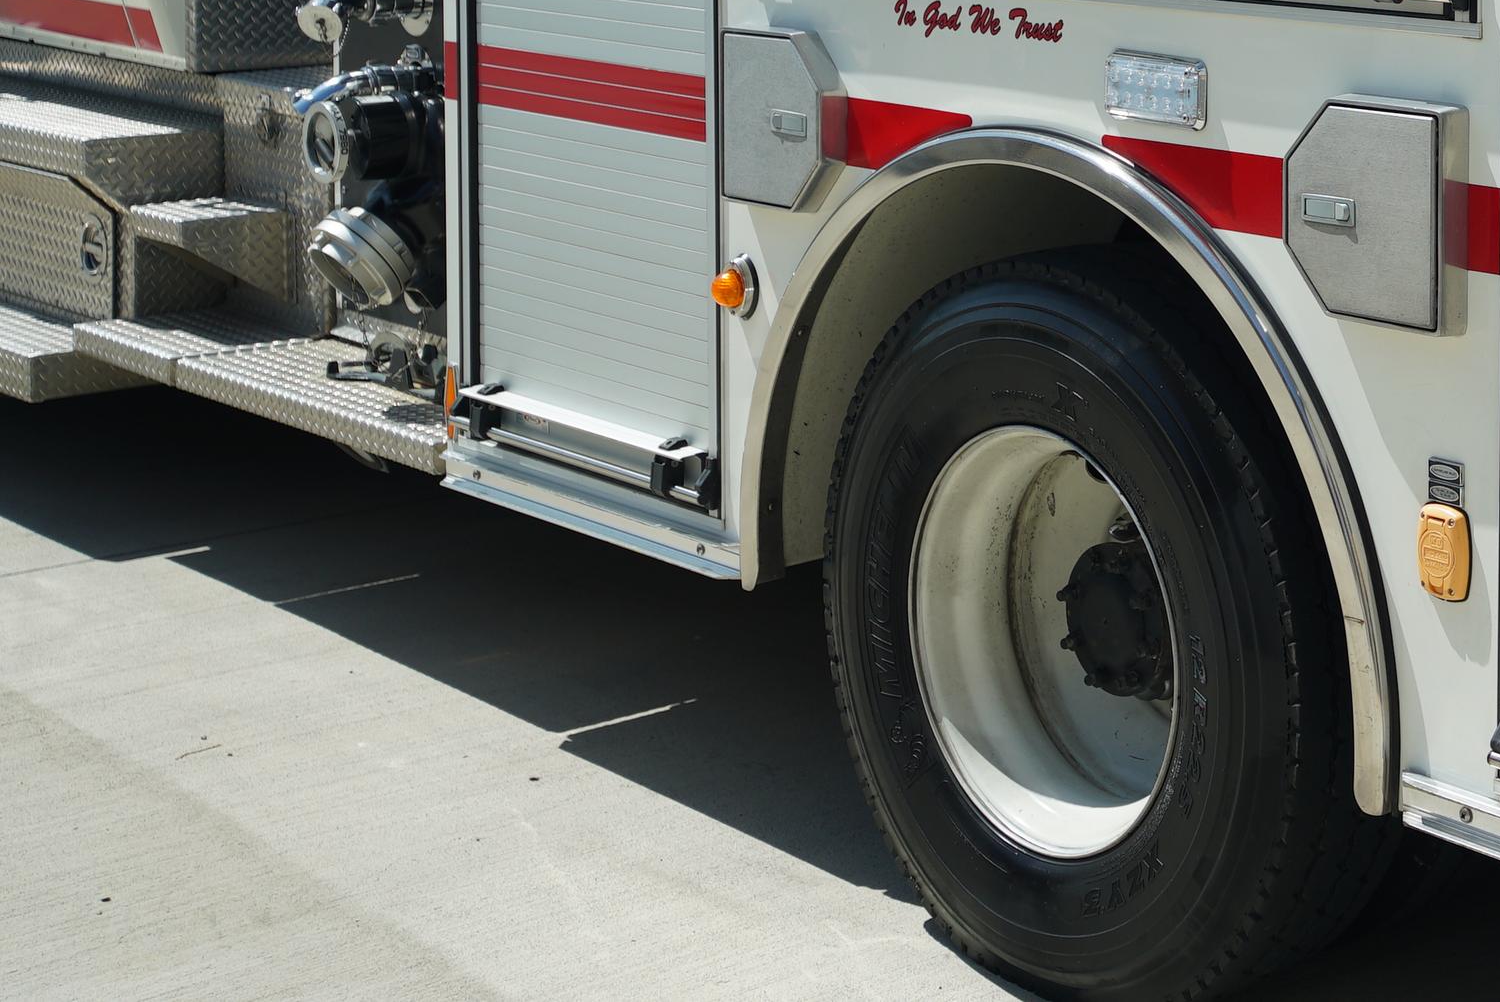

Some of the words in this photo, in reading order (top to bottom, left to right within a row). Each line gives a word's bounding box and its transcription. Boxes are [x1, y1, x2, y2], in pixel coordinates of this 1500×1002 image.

[922, 0, 963, 39] God
[968, 3, 1002, 36] We
[1008, 7, 1065, 44] Trust
